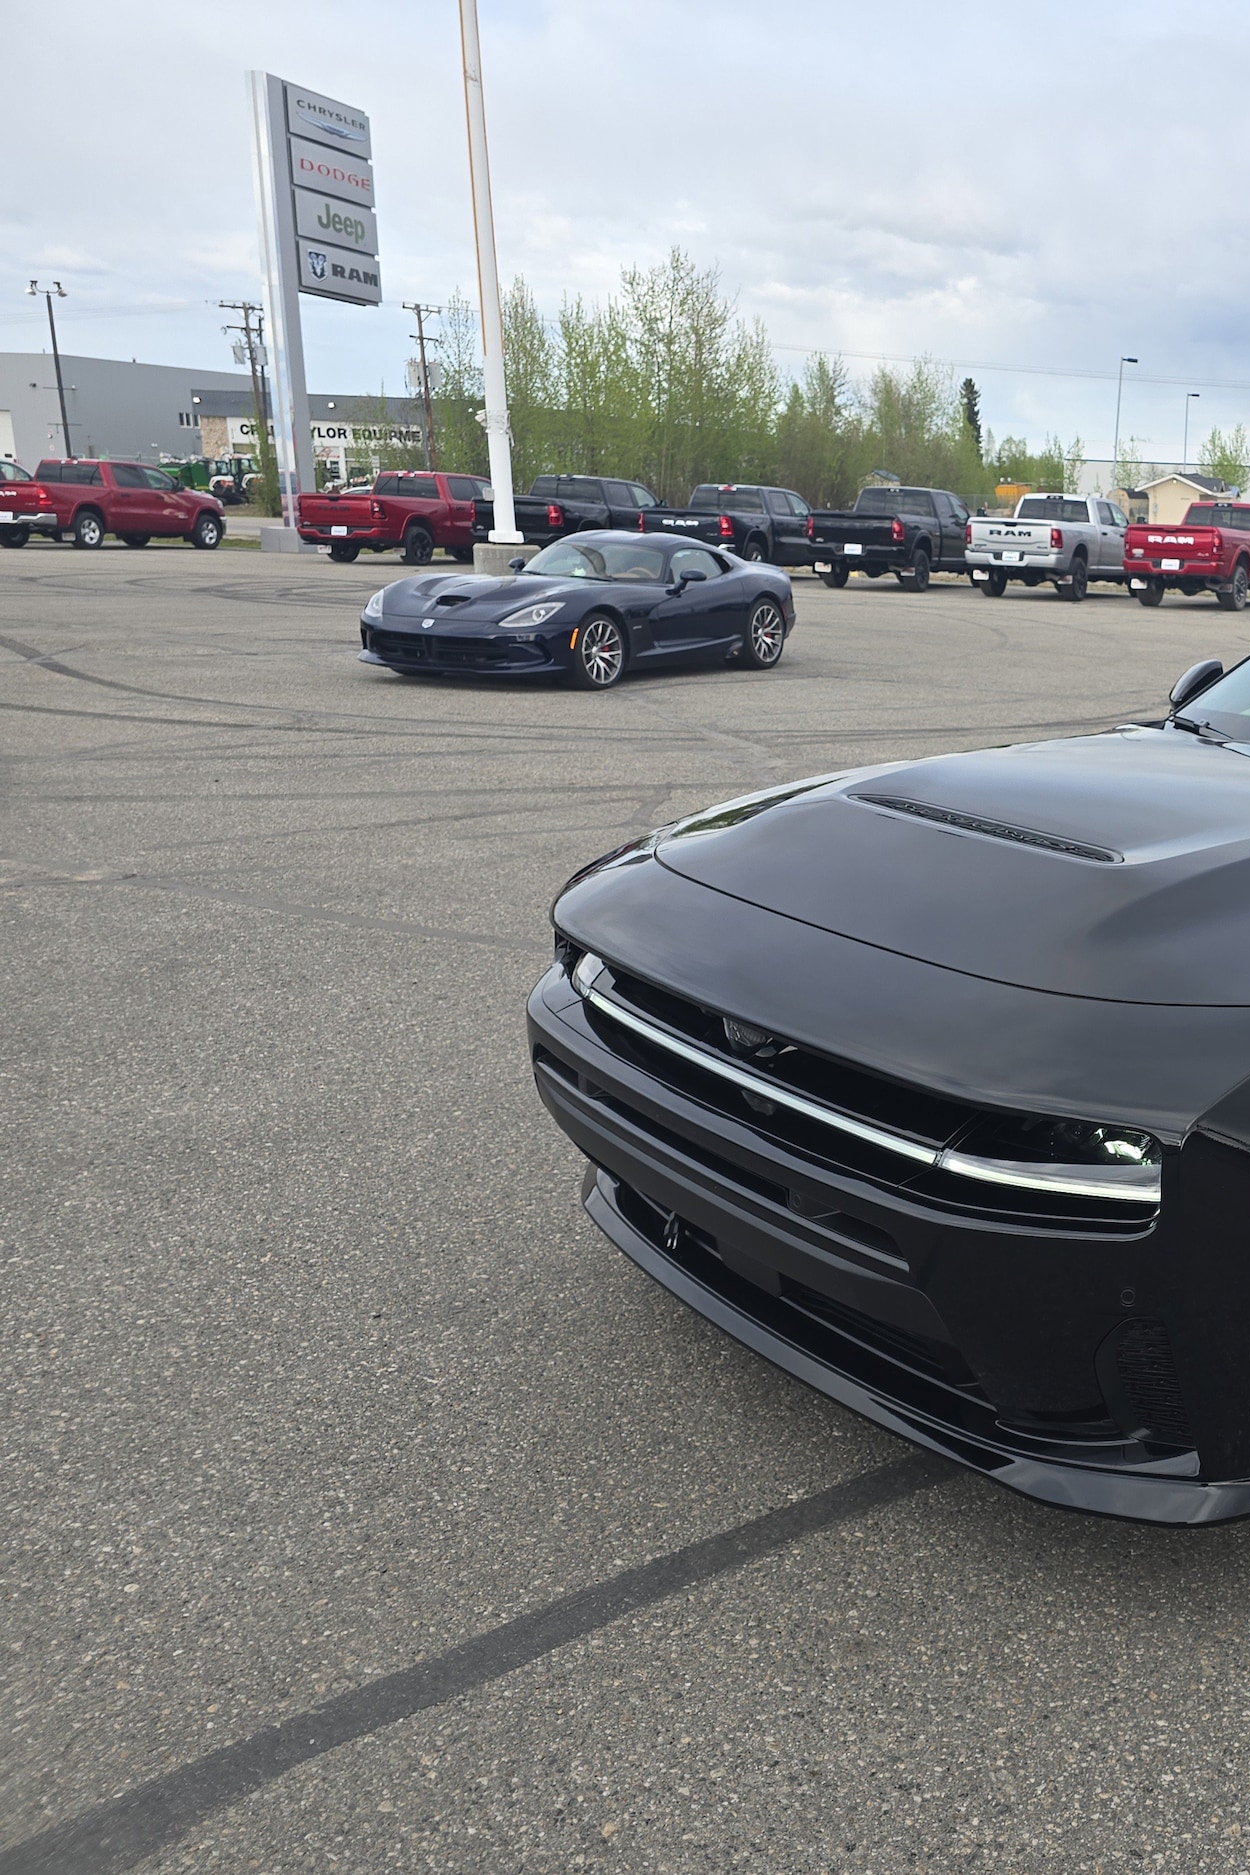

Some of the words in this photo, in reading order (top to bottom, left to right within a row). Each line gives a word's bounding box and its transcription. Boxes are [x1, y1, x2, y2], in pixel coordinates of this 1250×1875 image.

[296, 99, 367, 132] CHRYSLER
[300, 157, 371, 192] DODGE
[317, 203, 366, 244] Jeep
[331, 263, 379, 287] RAM
[989, 529, 1032, 537] RAM
[1147, 535, 1195, 545] RAM
